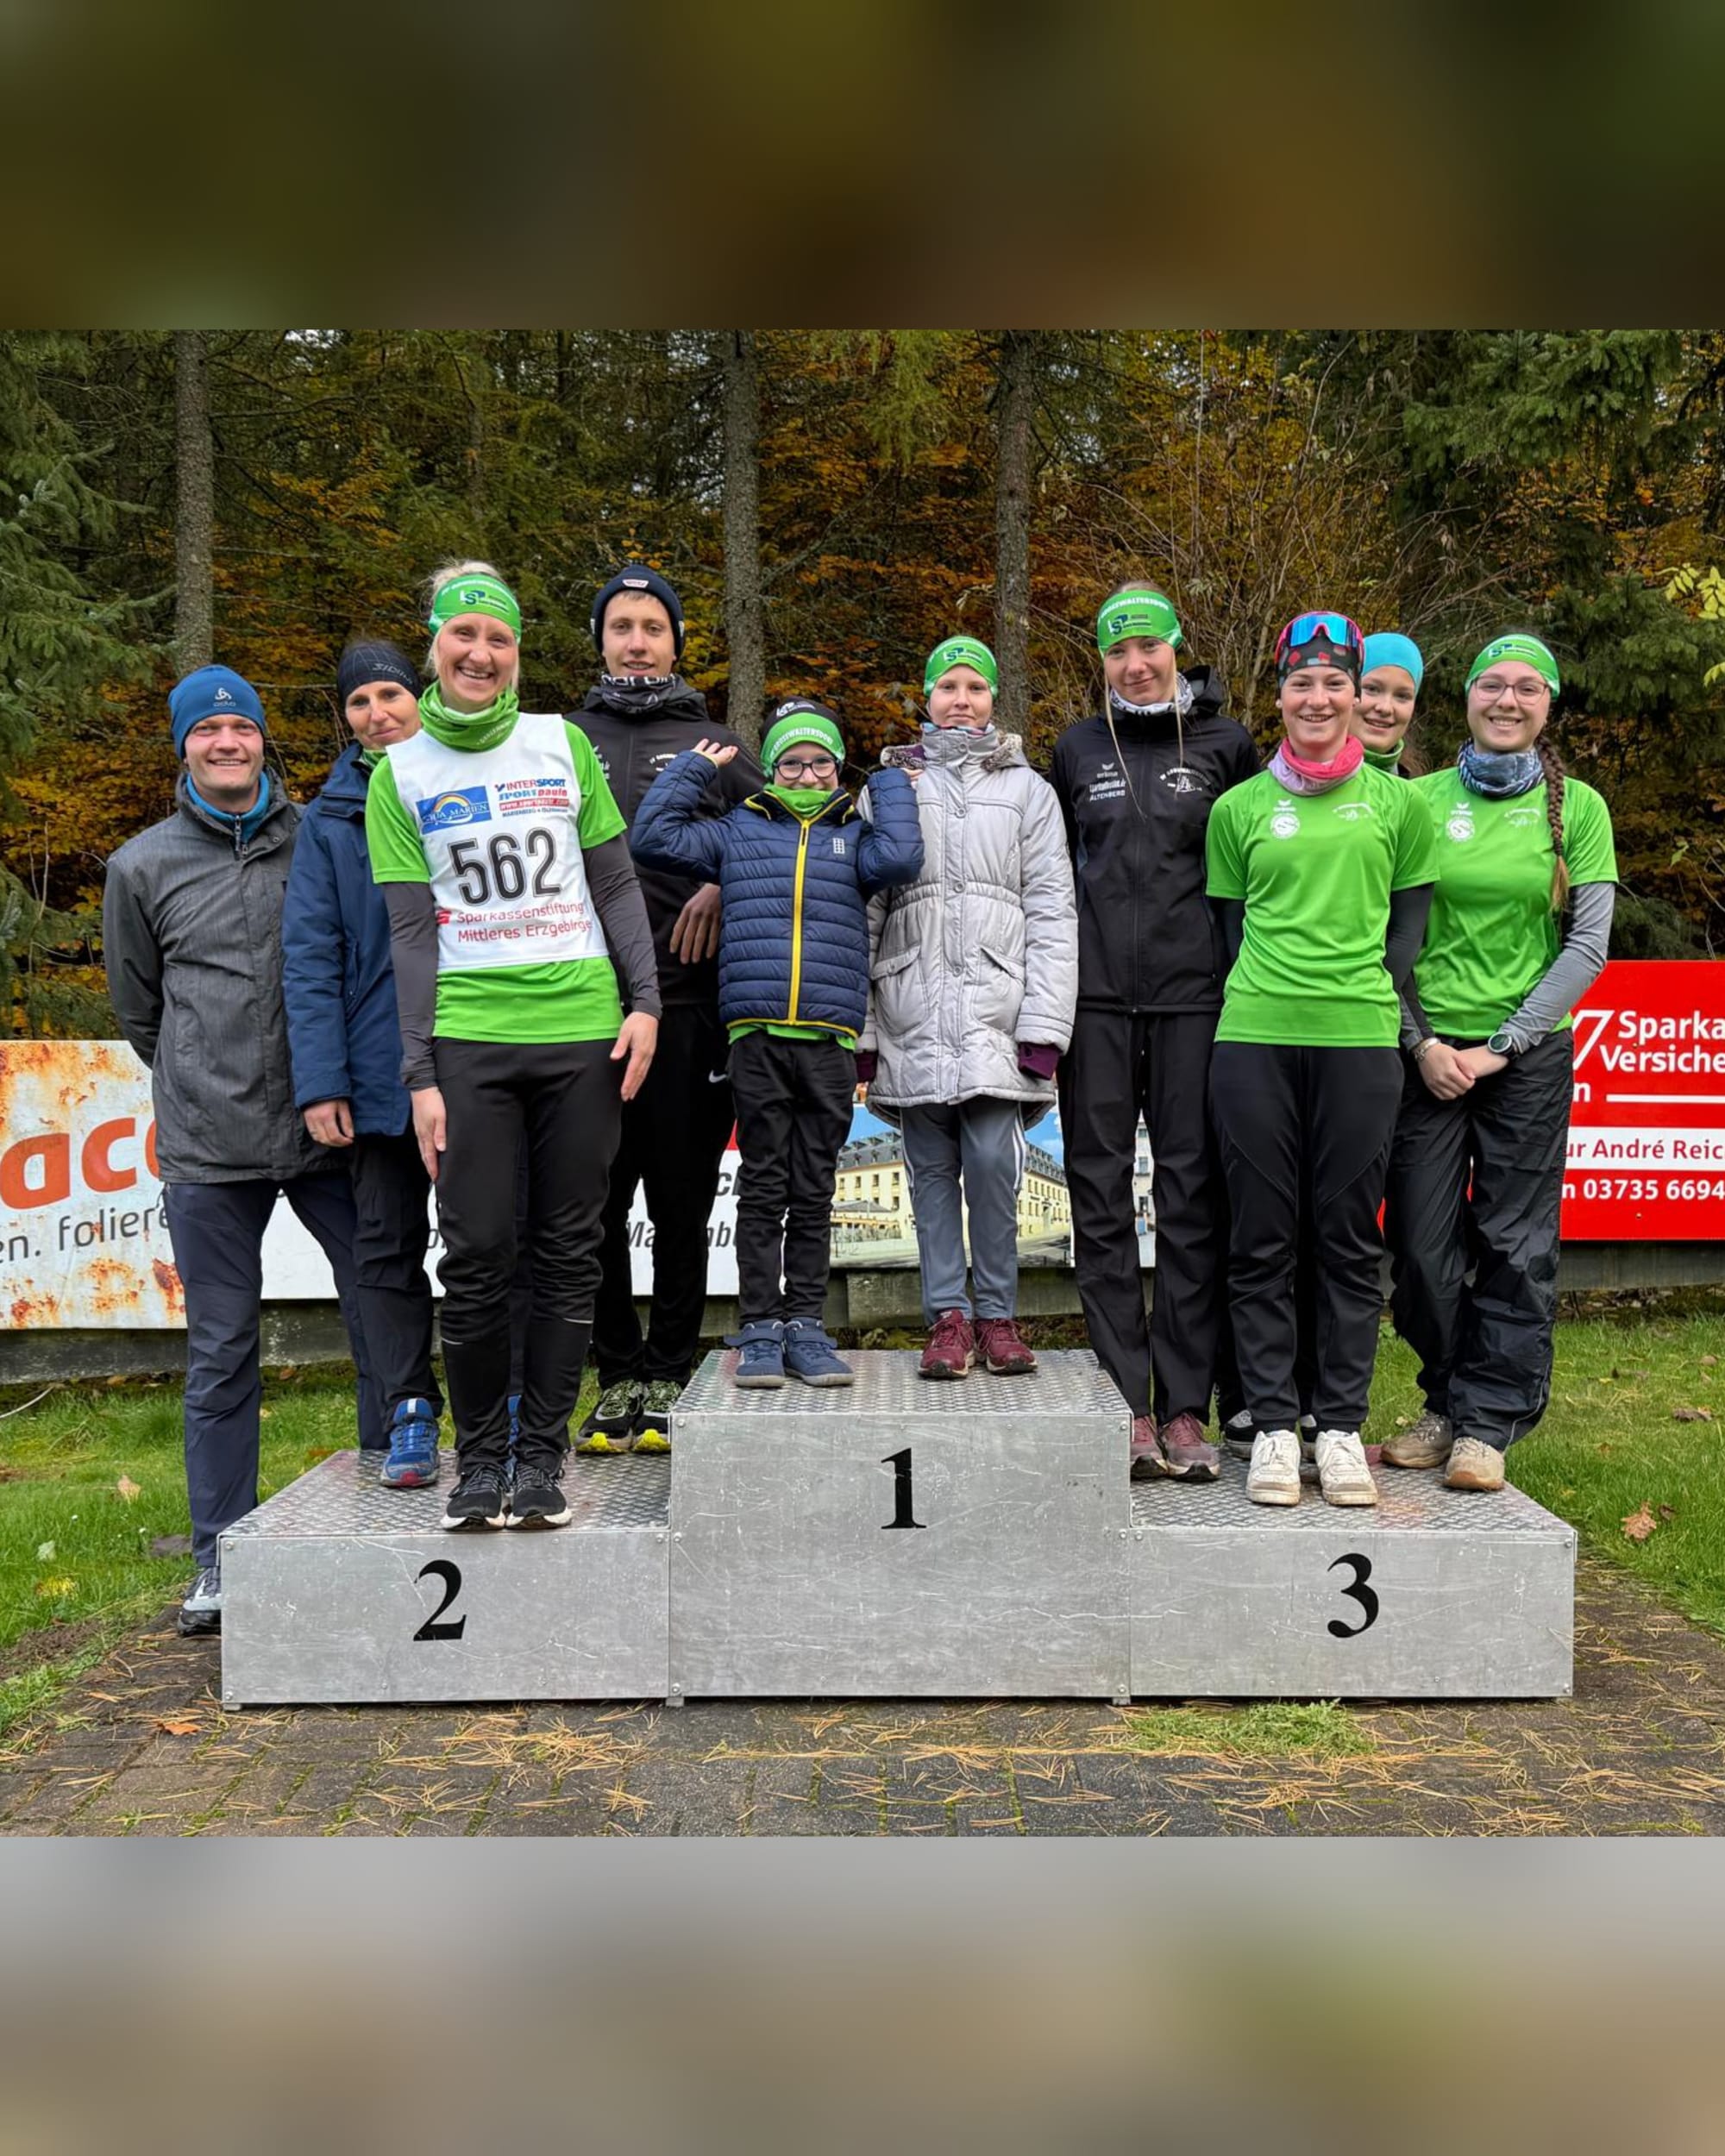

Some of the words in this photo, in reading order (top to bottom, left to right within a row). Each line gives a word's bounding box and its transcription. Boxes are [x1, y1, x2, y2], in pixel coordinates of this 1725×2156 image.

[507, 779, 566, 791] INTERSPORT
[448, 827, 561, 906] 562
[456, 902, 584, 926] Sparkassenstiftung
[458, 927, 520, 943] Mittleres
[525, 919, 593, 939] Erzgebirge
[1618, 1010, 1725, 1044] Sparka
[1599, 1044, 1725, 1073] Versiche
[1592, 1138, 1665, 1159] André
[1584, 1179, 1659, 1200] 03735
[1665, 1180, 1725, 1200] 6694
[881, 1447, 926, 1529] 1
[413, 1559, 467, 1641] 2
[1327, 1553, 1379, 1638] 3
